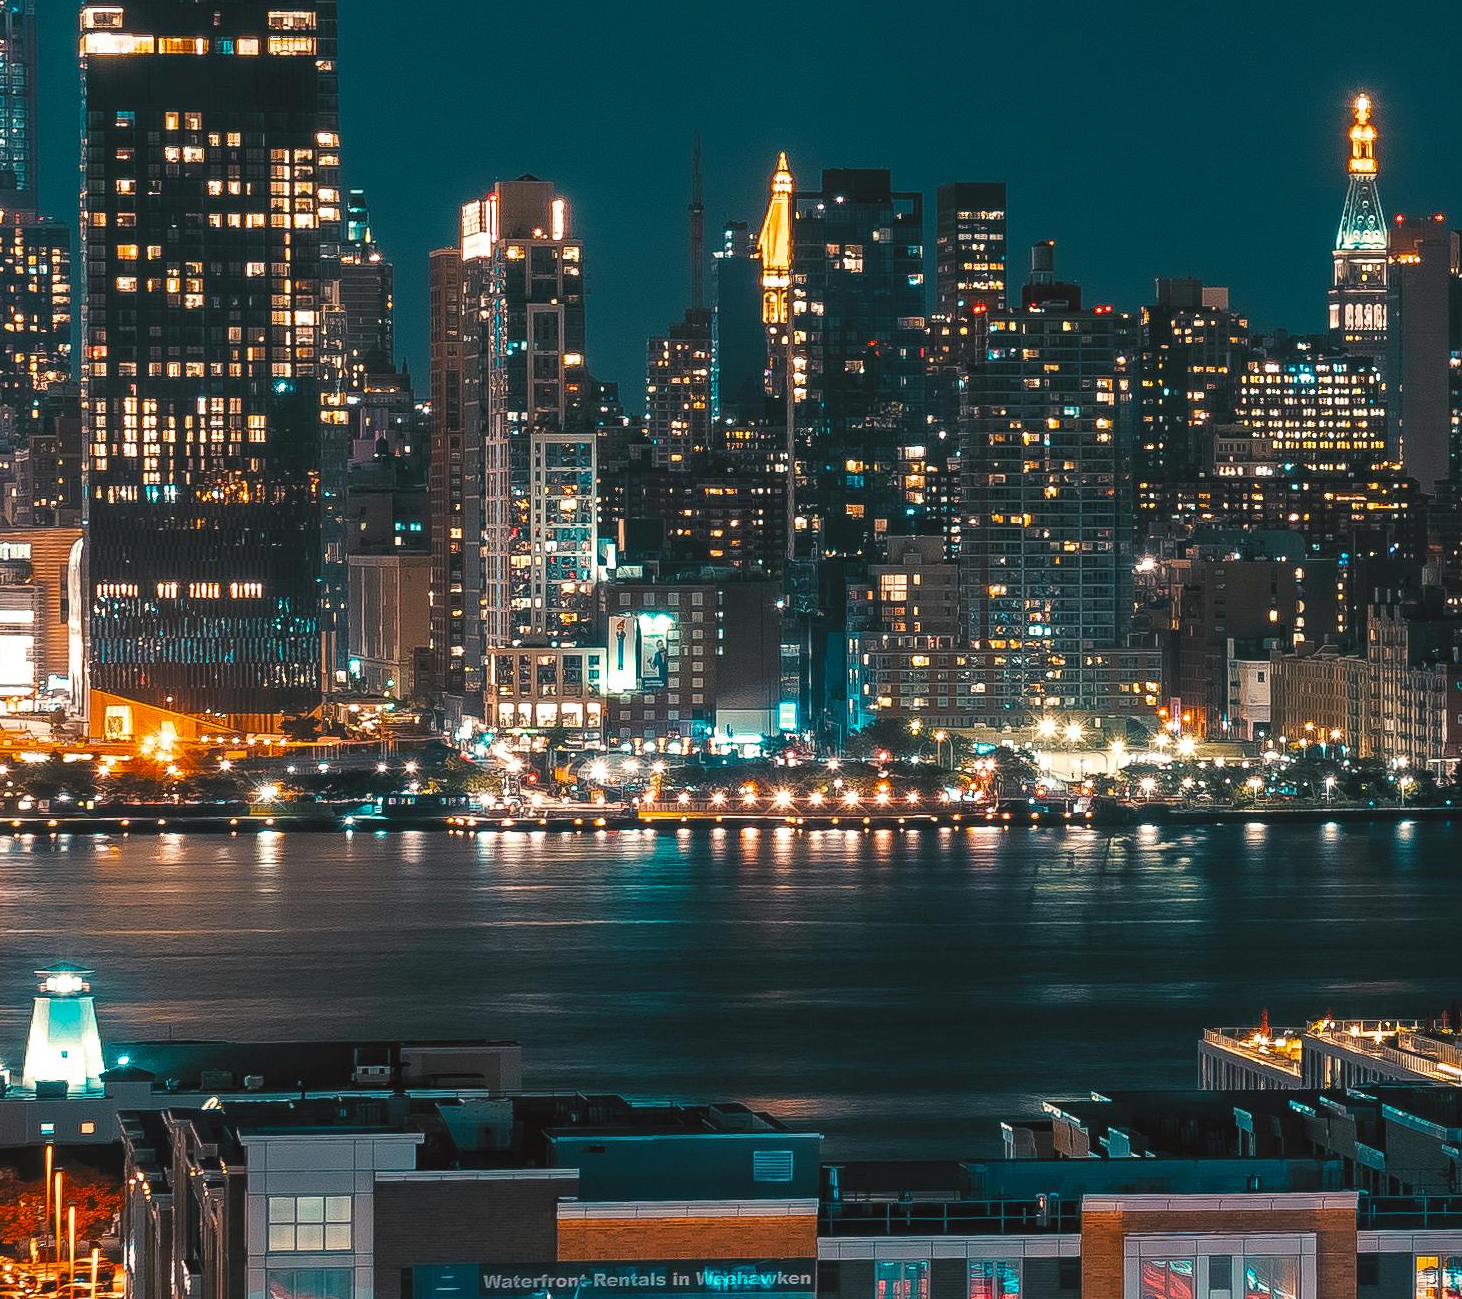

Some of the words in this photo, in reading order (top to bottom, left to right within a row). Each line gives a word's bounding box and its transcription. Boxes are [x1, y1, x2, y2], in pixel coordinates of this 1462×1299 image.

[483, 1273, 588, 1289] Waterfront
[594, 1272, 667, 1287] Rentals
[673, 1271, 689, 1286] in
[696, 1270, 811, 1287] Weehawken
